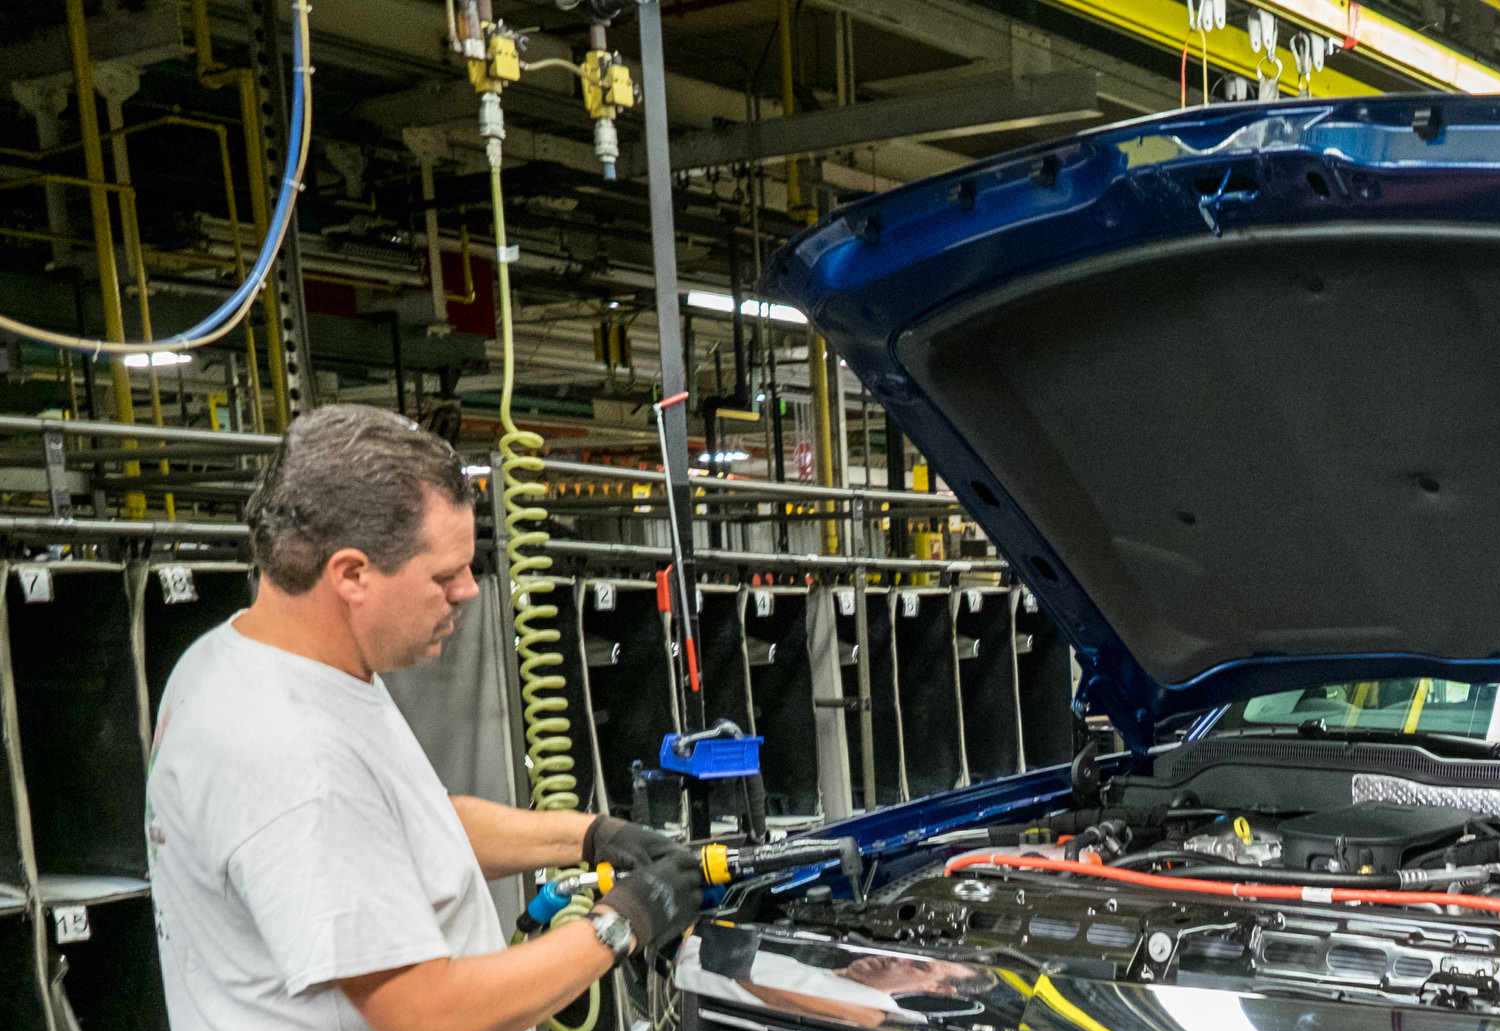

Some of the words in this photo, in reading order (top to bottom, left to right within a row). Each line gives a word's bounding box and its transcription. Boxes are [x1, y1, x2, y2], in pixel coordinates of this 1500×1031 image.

[24, 570, 40, 594] 7
[171, 573, 186, 593] 8
[599, 585, 610, 603] 2
[757, 594, 768, 609] 4
